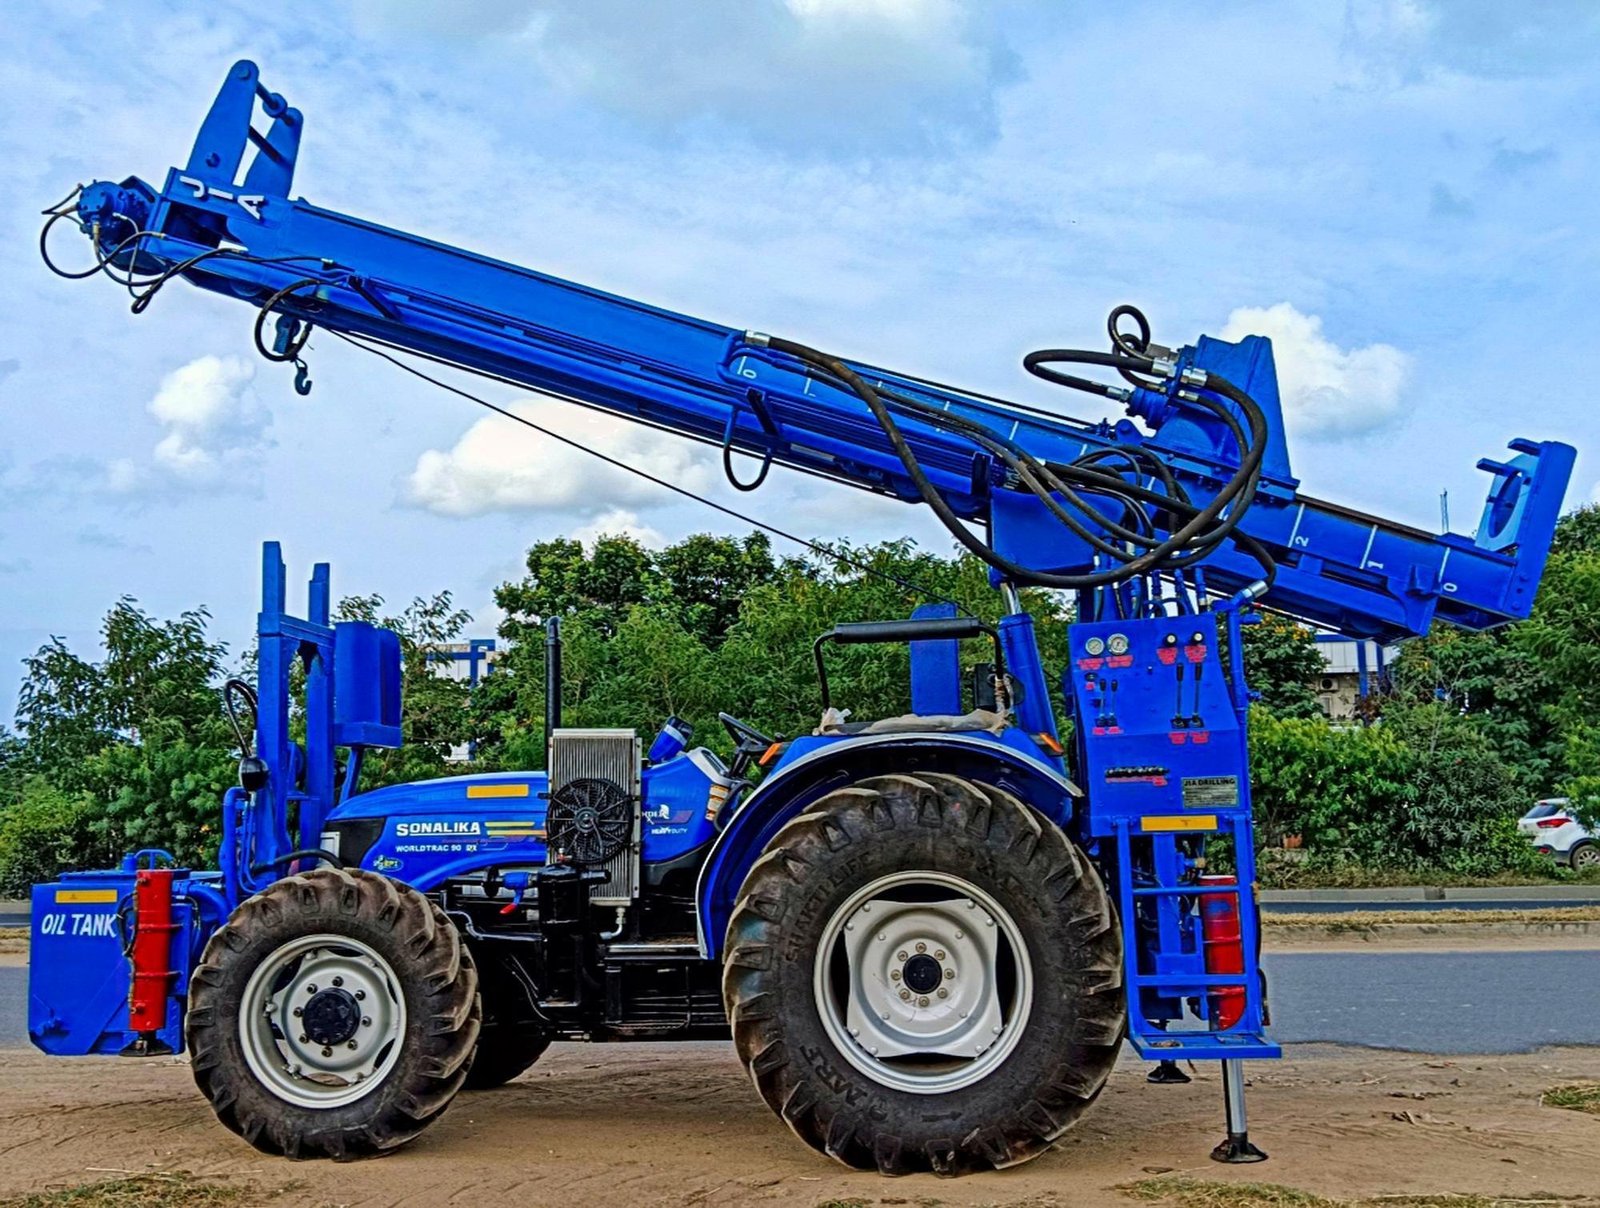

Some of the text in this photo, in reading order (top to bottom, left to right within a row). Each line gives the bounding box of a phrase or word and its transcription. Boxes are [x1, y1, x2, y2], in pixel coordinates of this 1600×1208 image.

[179, 176, 265, 220] JIA
[1294, 535, 1310, 547] 2
[1366, 559, 1385, 570] 1
[1442, 581, 1458, 593] 0
[1198, 777, 1236, 786] DRILLING
[396, 821, 481, 837] SONALIKA
[395, 844, 449, 853] WORLDTRAC
[451, 844, 462, 852] 90
[41, 912, 118, 938] OIL TANK
[799, 1044, 868, 1107] MRF
